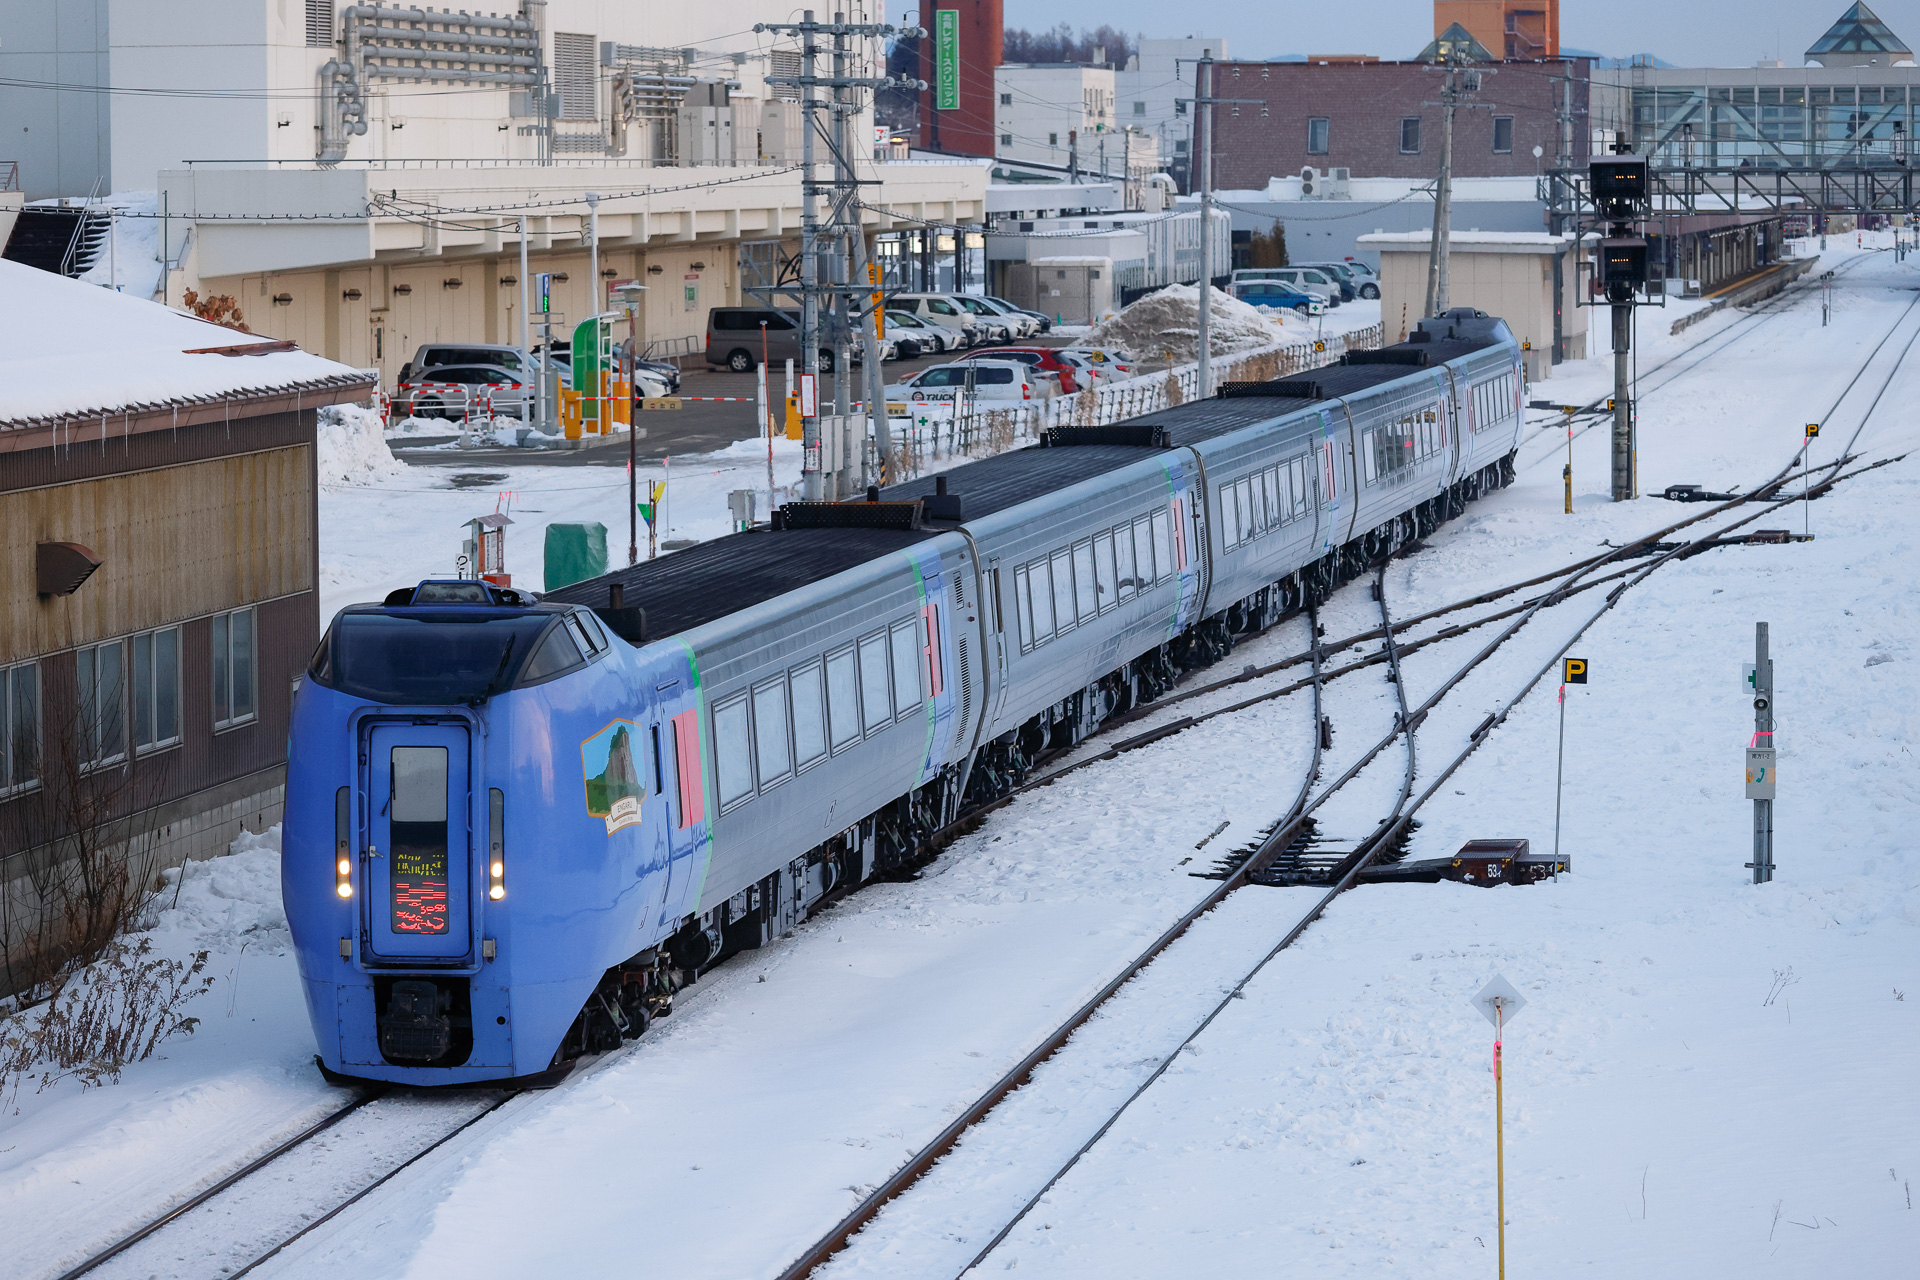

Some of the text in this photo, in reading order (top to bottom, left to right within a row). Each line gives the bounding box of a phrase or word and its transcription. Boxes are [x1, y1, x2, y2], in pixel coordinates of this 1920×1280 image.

[1523, 342, 1530, 350] P
[1807, 425, 1818, 436] P
[1566, 659, 1585, 682] P
